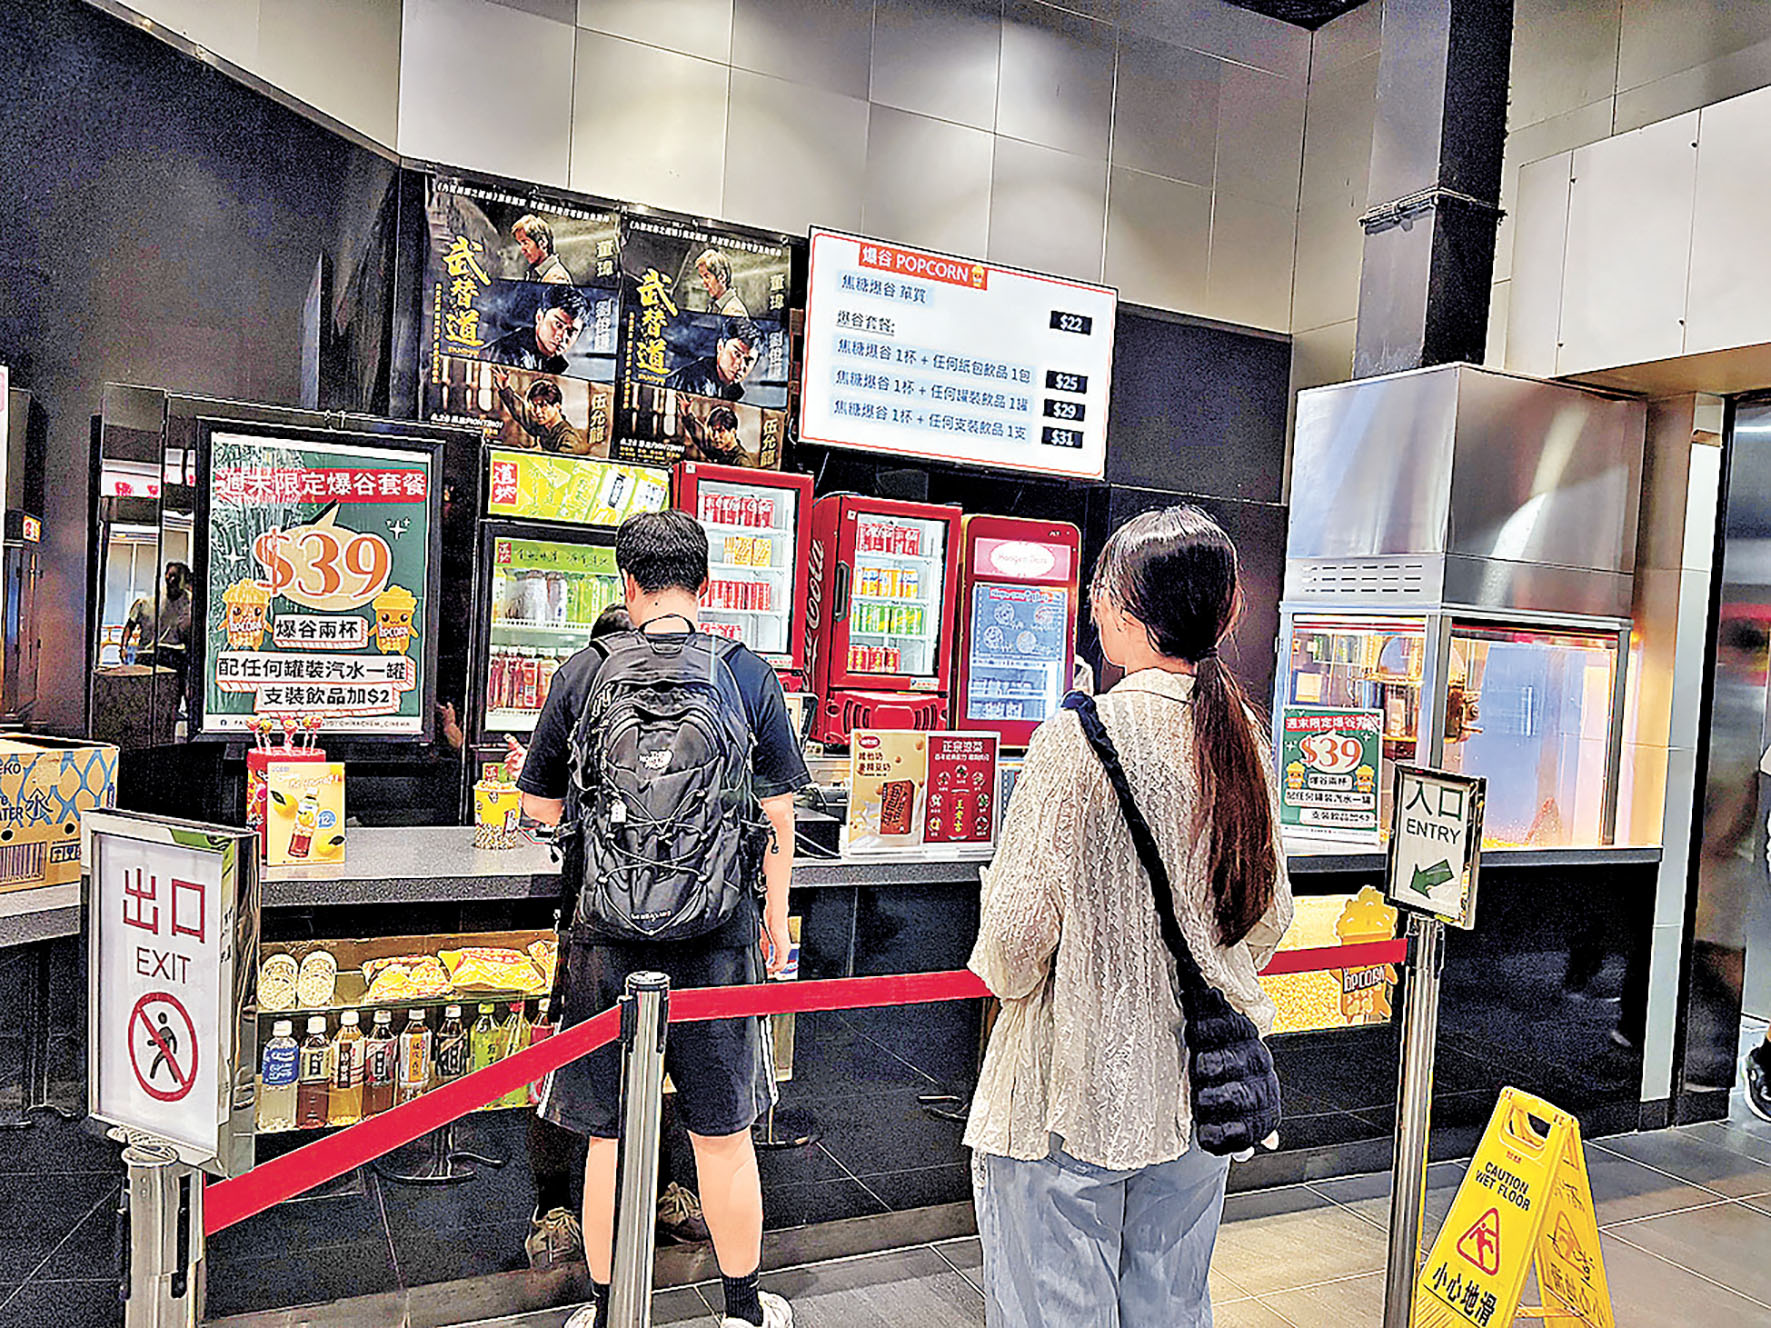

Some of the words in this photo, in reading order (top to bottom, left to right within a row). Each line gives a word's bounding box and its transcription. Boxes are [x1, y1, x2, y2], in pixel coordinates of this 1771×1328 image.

[862, 246, 892, 267] 爆谷
[896, 253, 969, 282] POPCORN
[442, 235, 492, 347] 武替道
[636, 268, 678, 374] 武替道
[1060, 314, 1083, 331] $22
[896, 348, 917, 364] 1杯
[1011, 368, 1031, 384] 1包
[1055, 373, 1078, 391] $25
[893, 379, 914, 395] 1杯
[1053, 402, 1077, 419] $29
[892, 408, 912, 424] 1杯
[1007, 425, 1026, 440] 1支
[1051, 429, 1074, 446] $31
[255, 528, 389, 598] $39
[276, 620, 358, 639] 爆谷兩杯
[218, 658, 406, 680] 配任何罐裝汽水一罐
[263, 686, 390, 705] 支裝飲品加$2
[1301, 737, 1361, 768] $39
[1405, 780, 1463, 821] 入口
[1406, 818, 1461, 845] ENTRY
[123, 868, 205, 944] 出口
[137, 946, 191, 984] EXIT
[1476, 1169, 1495, 1190] WET
[1497, 1183, 1531, 1211] FLOOR
[1485, 1162, 1529, 1195] CAUTION
[1433, 1262, 1497, 1327] 小心地滑
